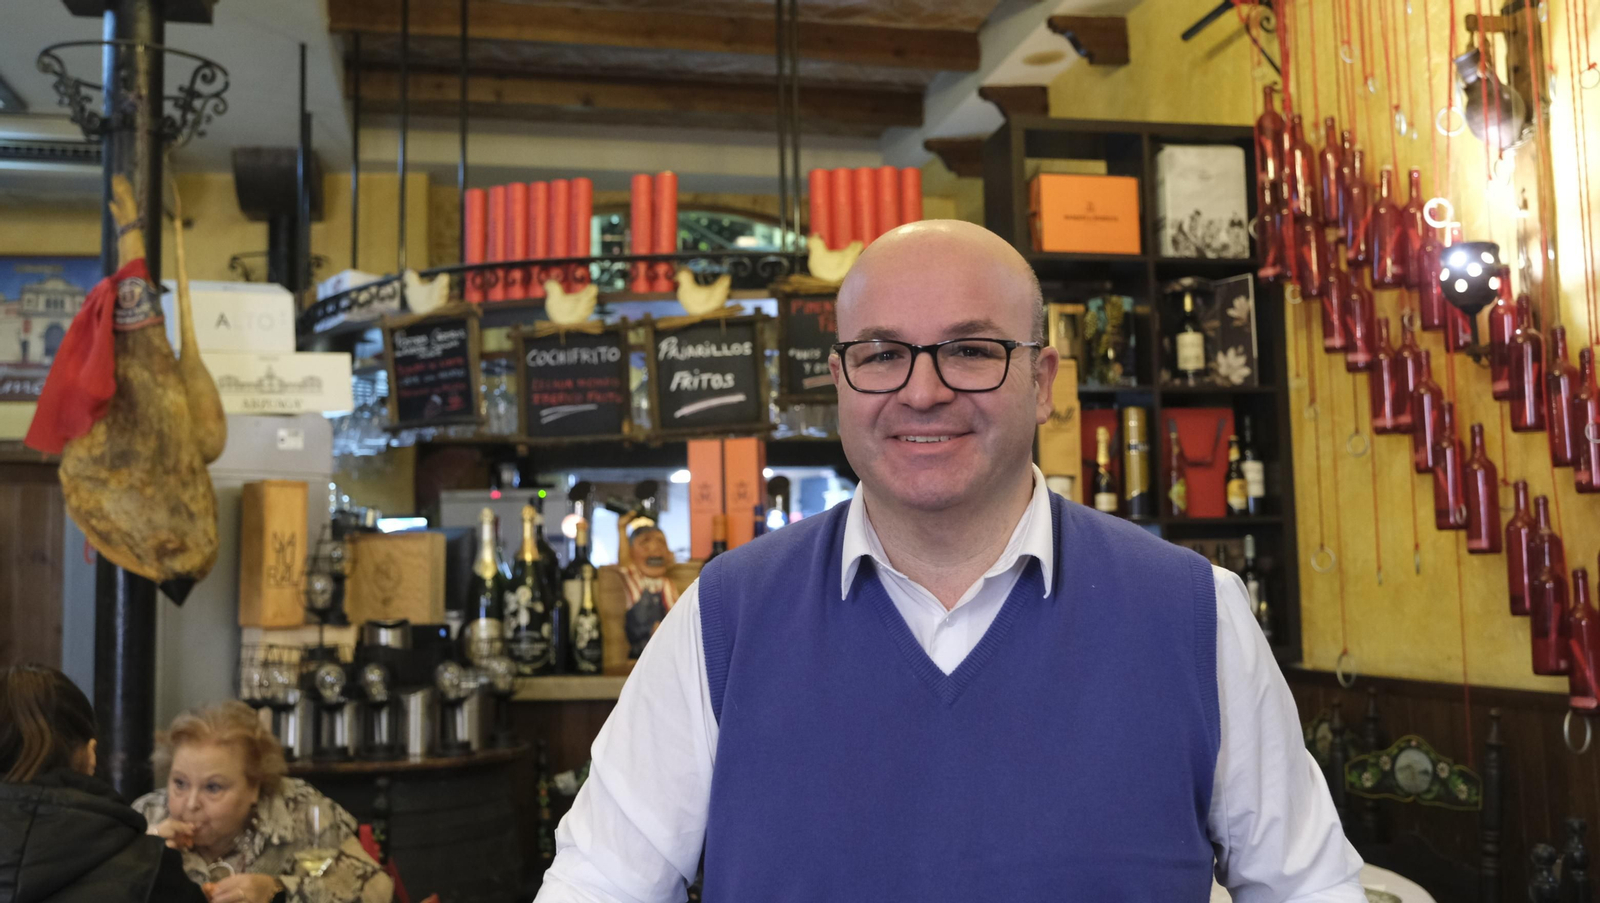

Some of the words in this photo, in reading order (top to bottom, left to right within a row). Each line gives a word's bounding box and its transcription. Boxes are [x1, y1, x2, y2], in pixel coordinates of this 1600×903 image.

[526, 346, 621, 367] COCHIFRITO
[658, 336, 753, 361] PAJARILLOS
[669, 368, 736, 392] FRITOS
